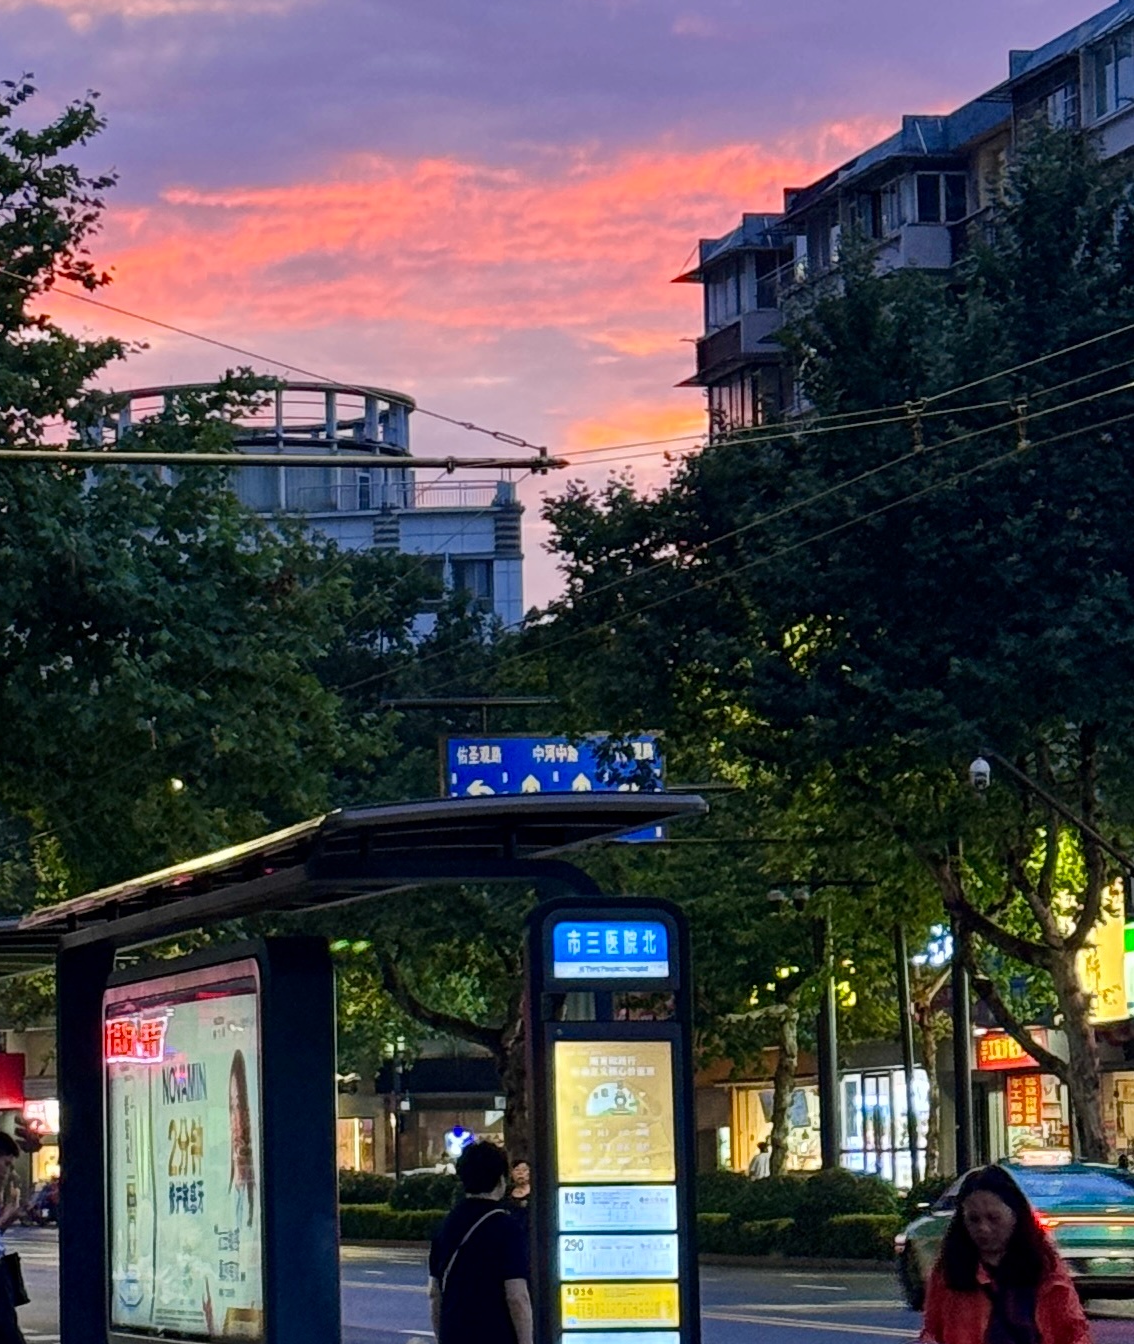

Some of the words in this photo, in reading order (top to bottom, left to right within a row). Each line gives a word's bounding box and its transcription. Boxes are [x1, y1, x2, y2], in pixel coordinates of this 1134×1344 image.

[567, 929, 657, 955] 市三医院北
[564, 1239, 584, 1252] 290
